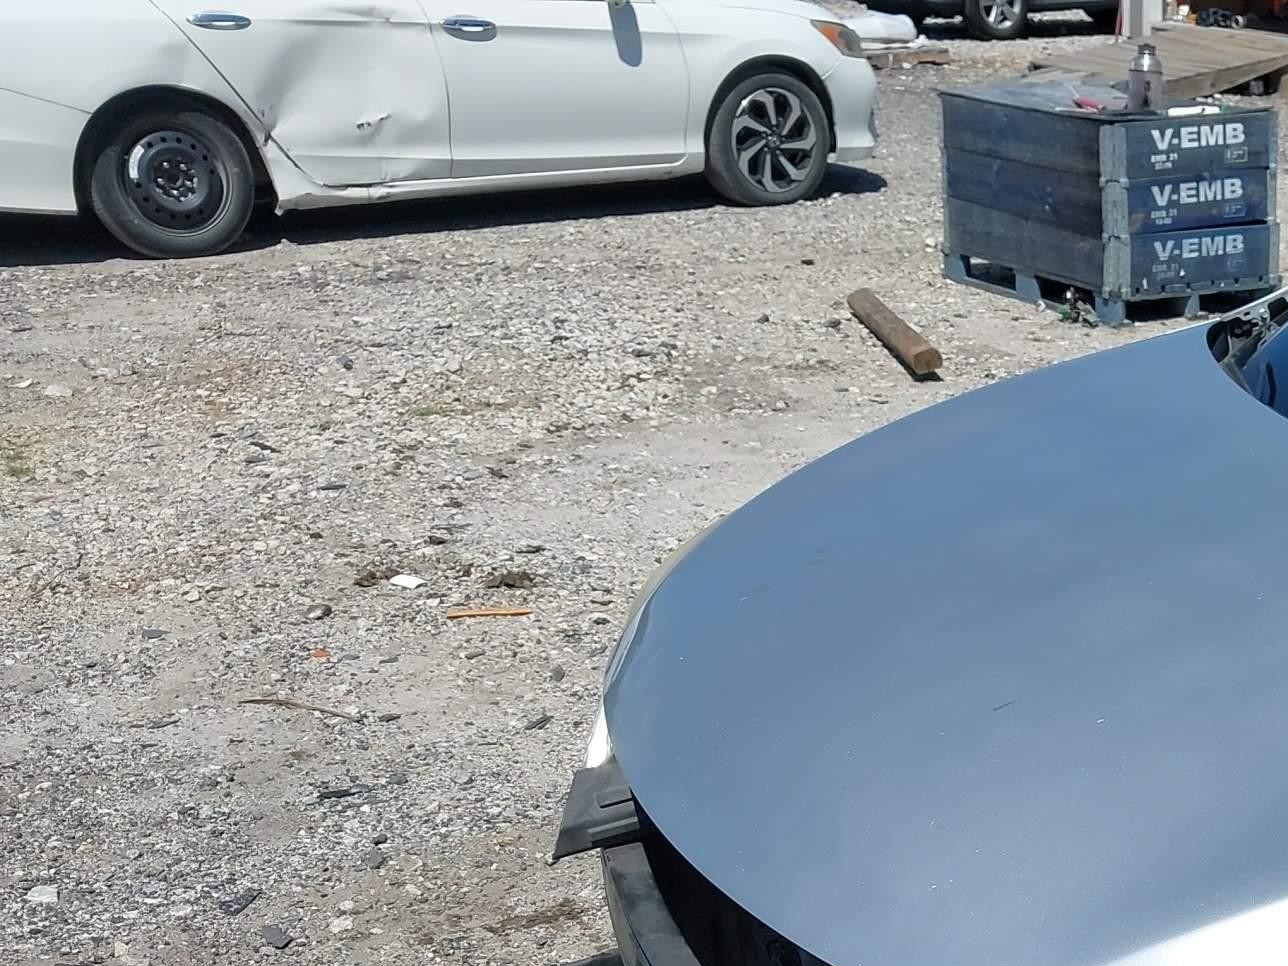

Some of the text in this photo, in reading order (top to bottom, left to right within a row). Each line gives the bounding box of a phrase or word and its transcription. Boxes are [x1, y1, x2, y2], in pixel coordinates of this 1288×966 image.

[1151, 123, 1245, 151] V-EMB
[1150, 178, 1243, 206] V-EMB
[1153, 234, 1244, 261] V-EMB
